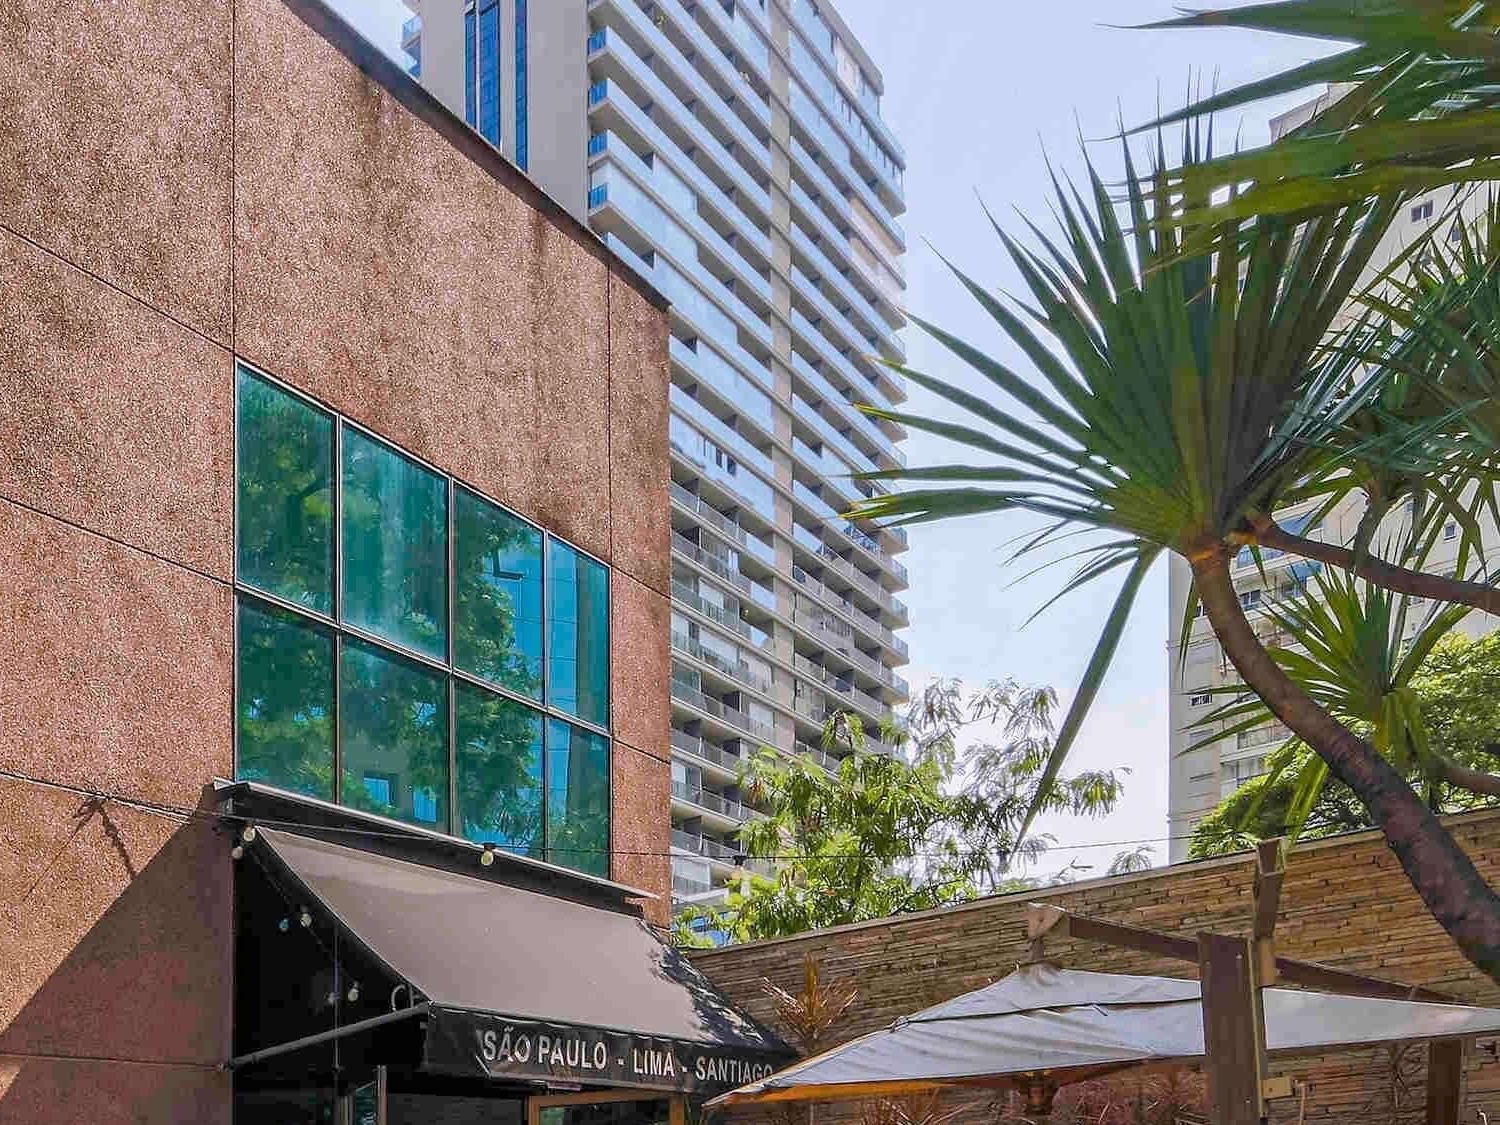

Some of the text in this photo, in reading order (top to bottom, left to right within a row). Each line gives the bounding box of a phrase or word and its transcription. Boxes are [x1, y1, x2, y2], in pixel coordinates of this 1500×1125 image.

[482, 1026, 531, 1063] SÃO
[537, 1036, 608, 1070] PAULO
[632, 1047, 676, 1078] LIMA
[695, 1055, 773, 1084] SANTIAGO
